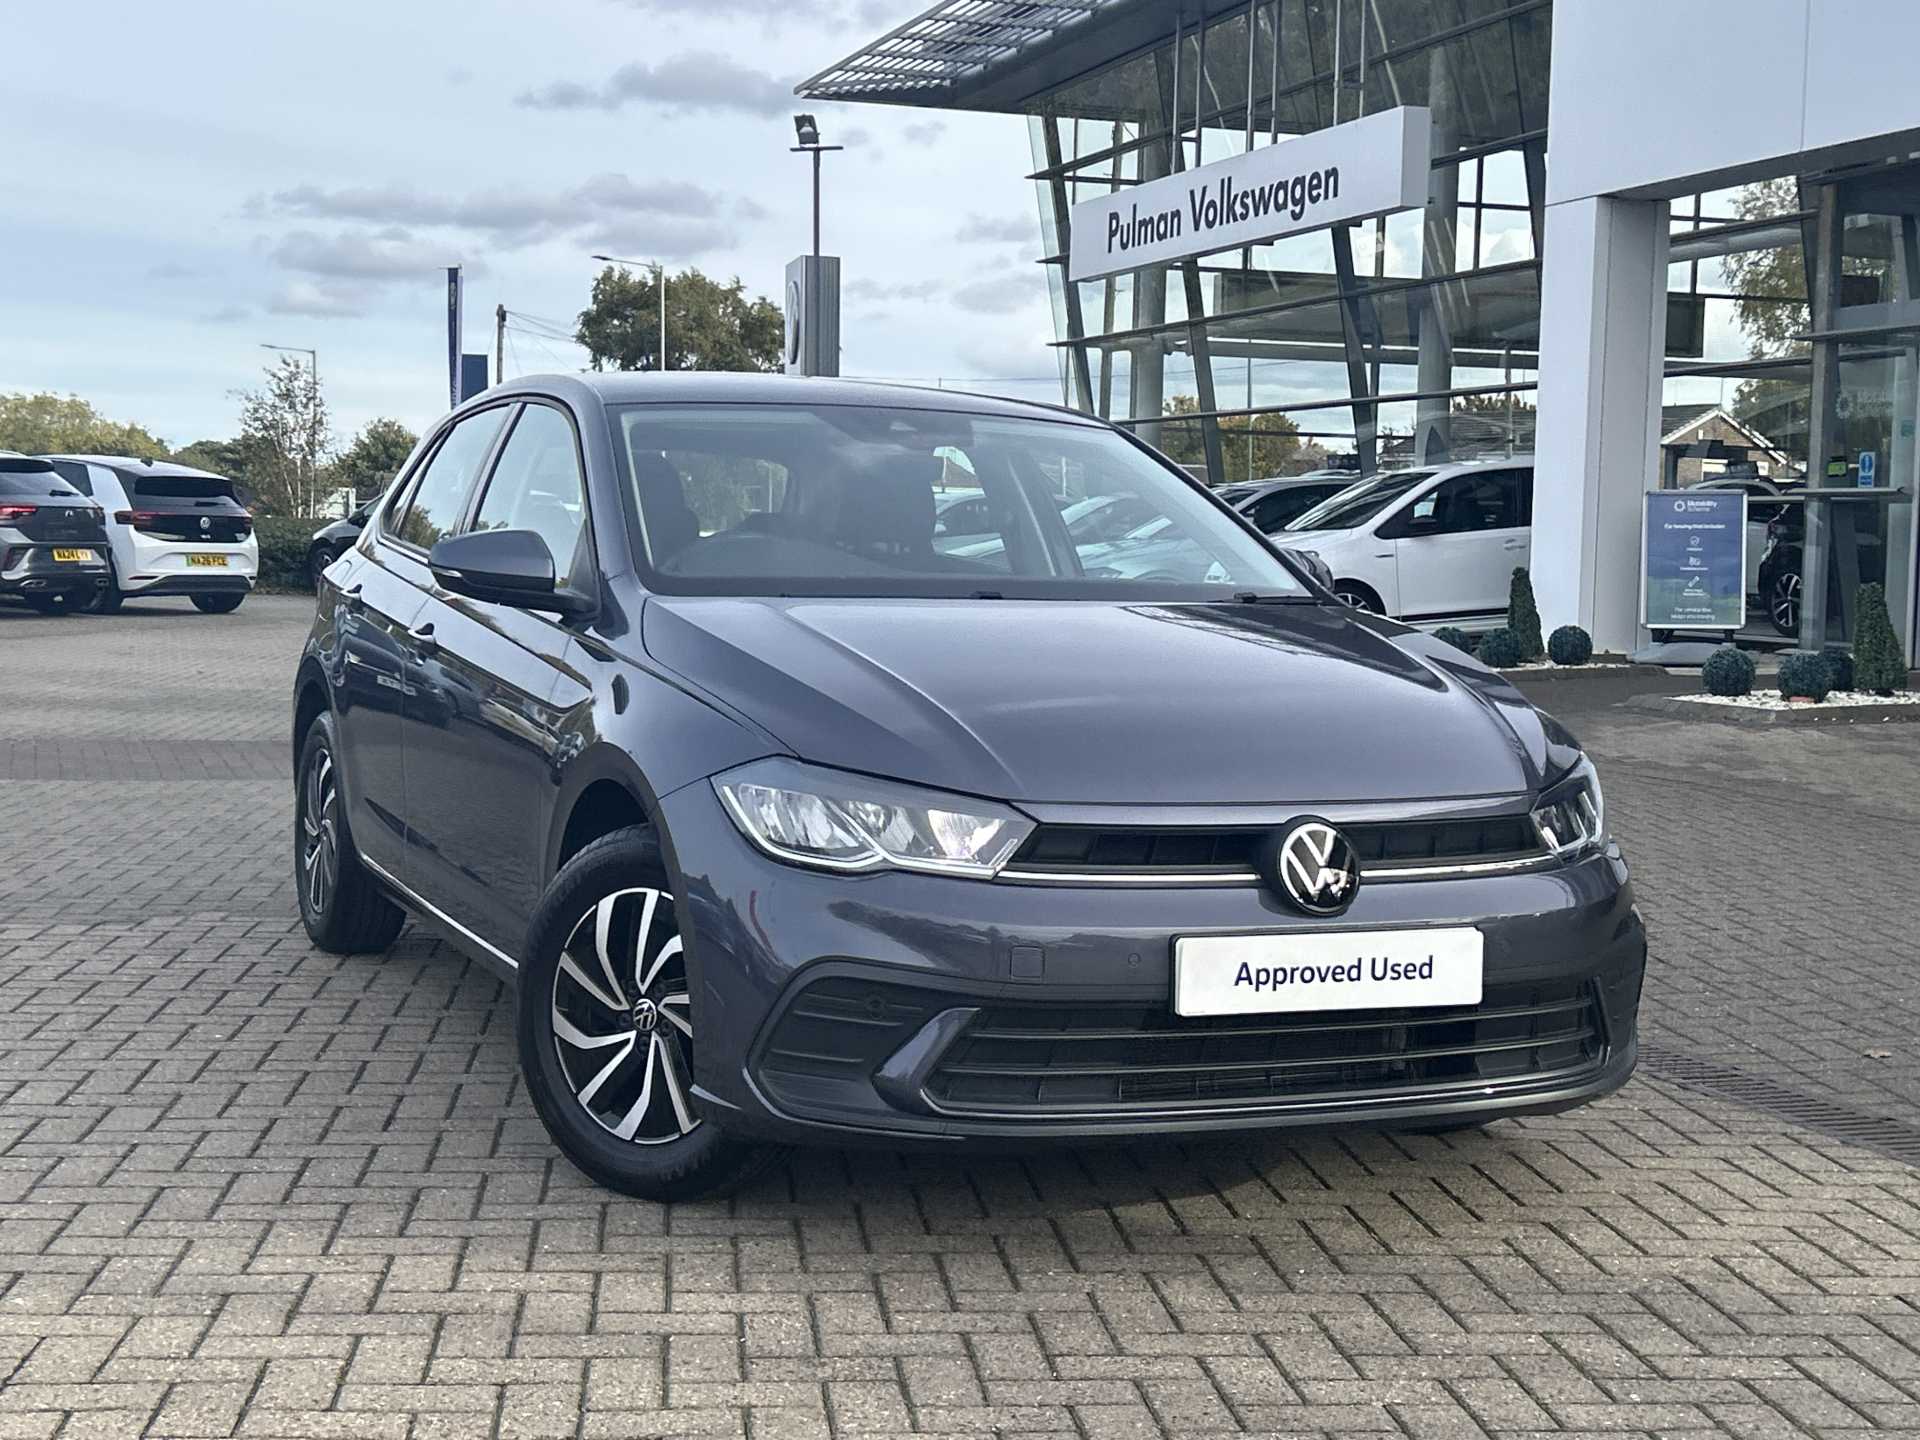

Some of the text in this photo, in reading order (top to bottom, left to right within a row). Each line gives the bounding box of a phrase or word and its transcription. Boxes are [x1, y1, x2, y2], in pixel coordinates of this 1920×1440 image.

[1108, 166, 1340, 254] Pulman Volkswagen
[1234, 955, 1434, 992] Approved Used
